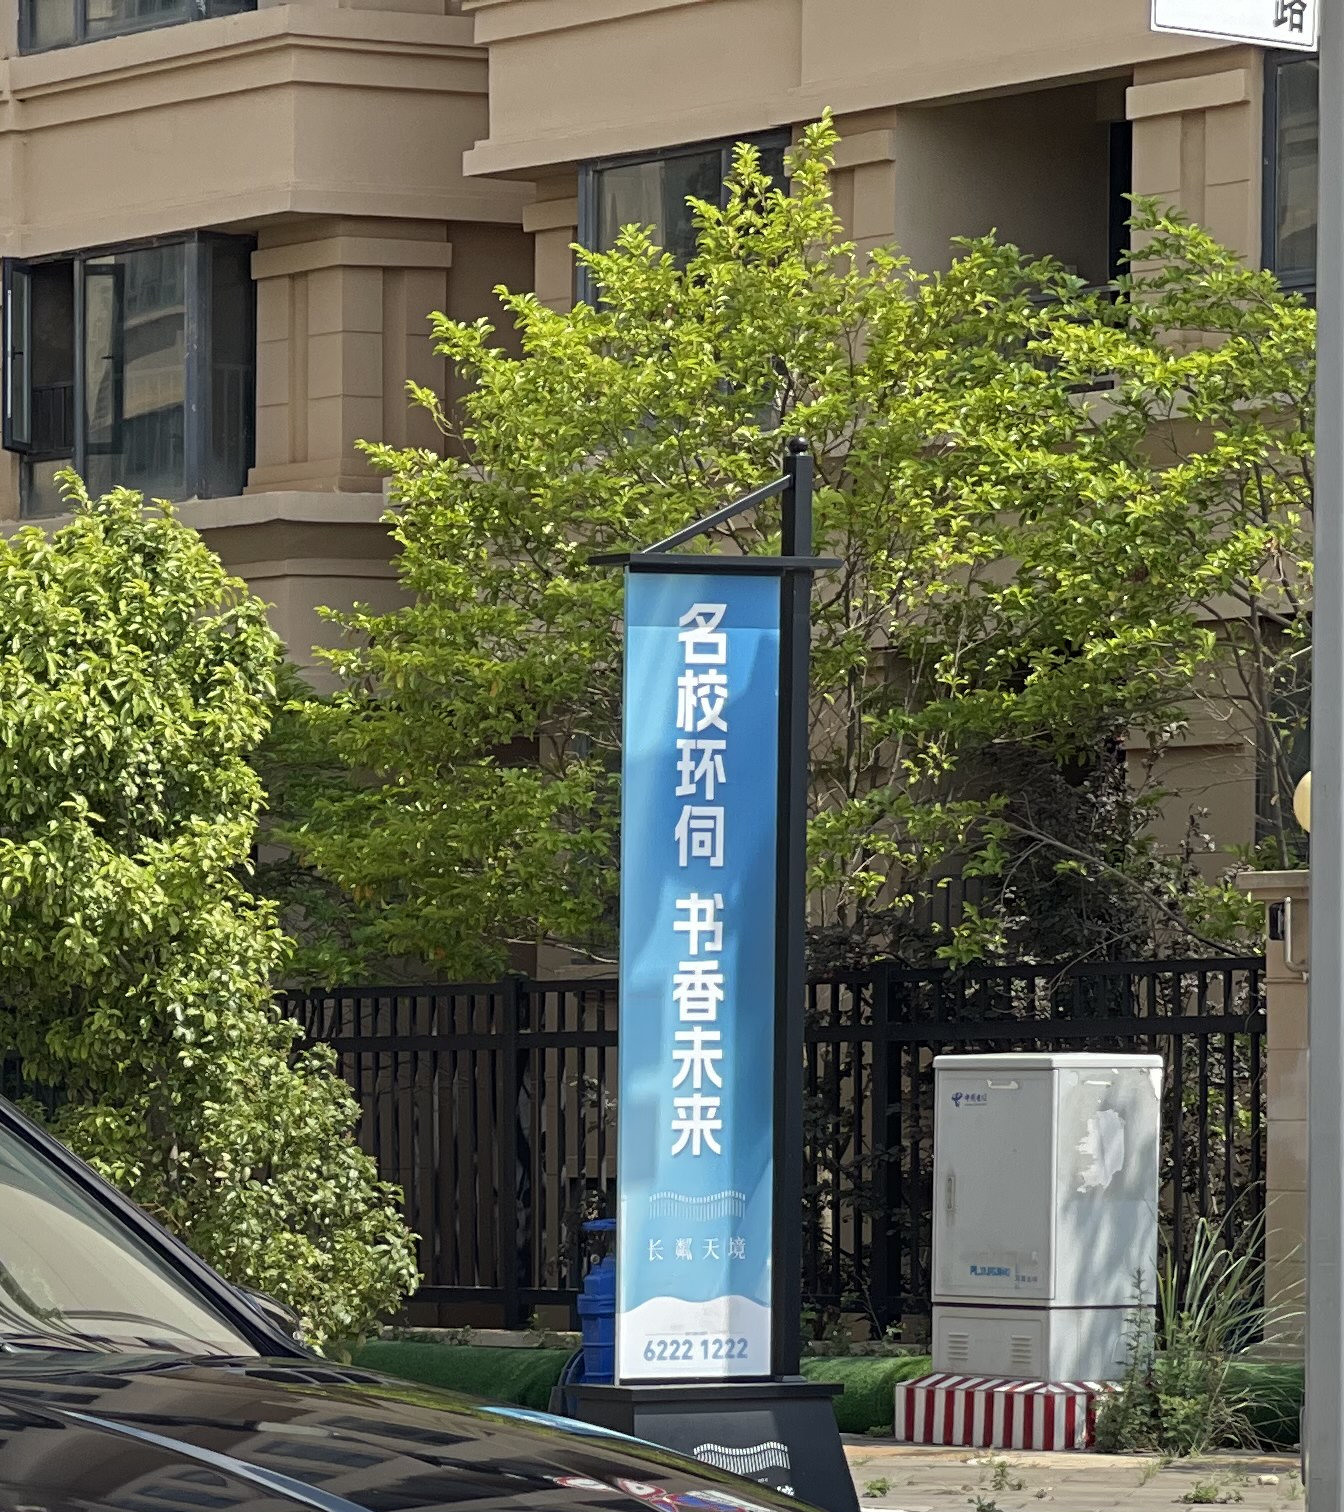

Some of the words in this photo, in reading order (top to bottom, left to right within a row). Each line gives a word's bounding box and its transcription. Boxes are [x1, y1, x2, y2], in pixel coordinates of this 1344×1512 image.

[674, 602, 729, 868] 名校环伺
[670, 892, 725, 1157] 书香未来
[643, 1339, 694, 1361] 6222
[700, 1338, 748, 1360] 1222
